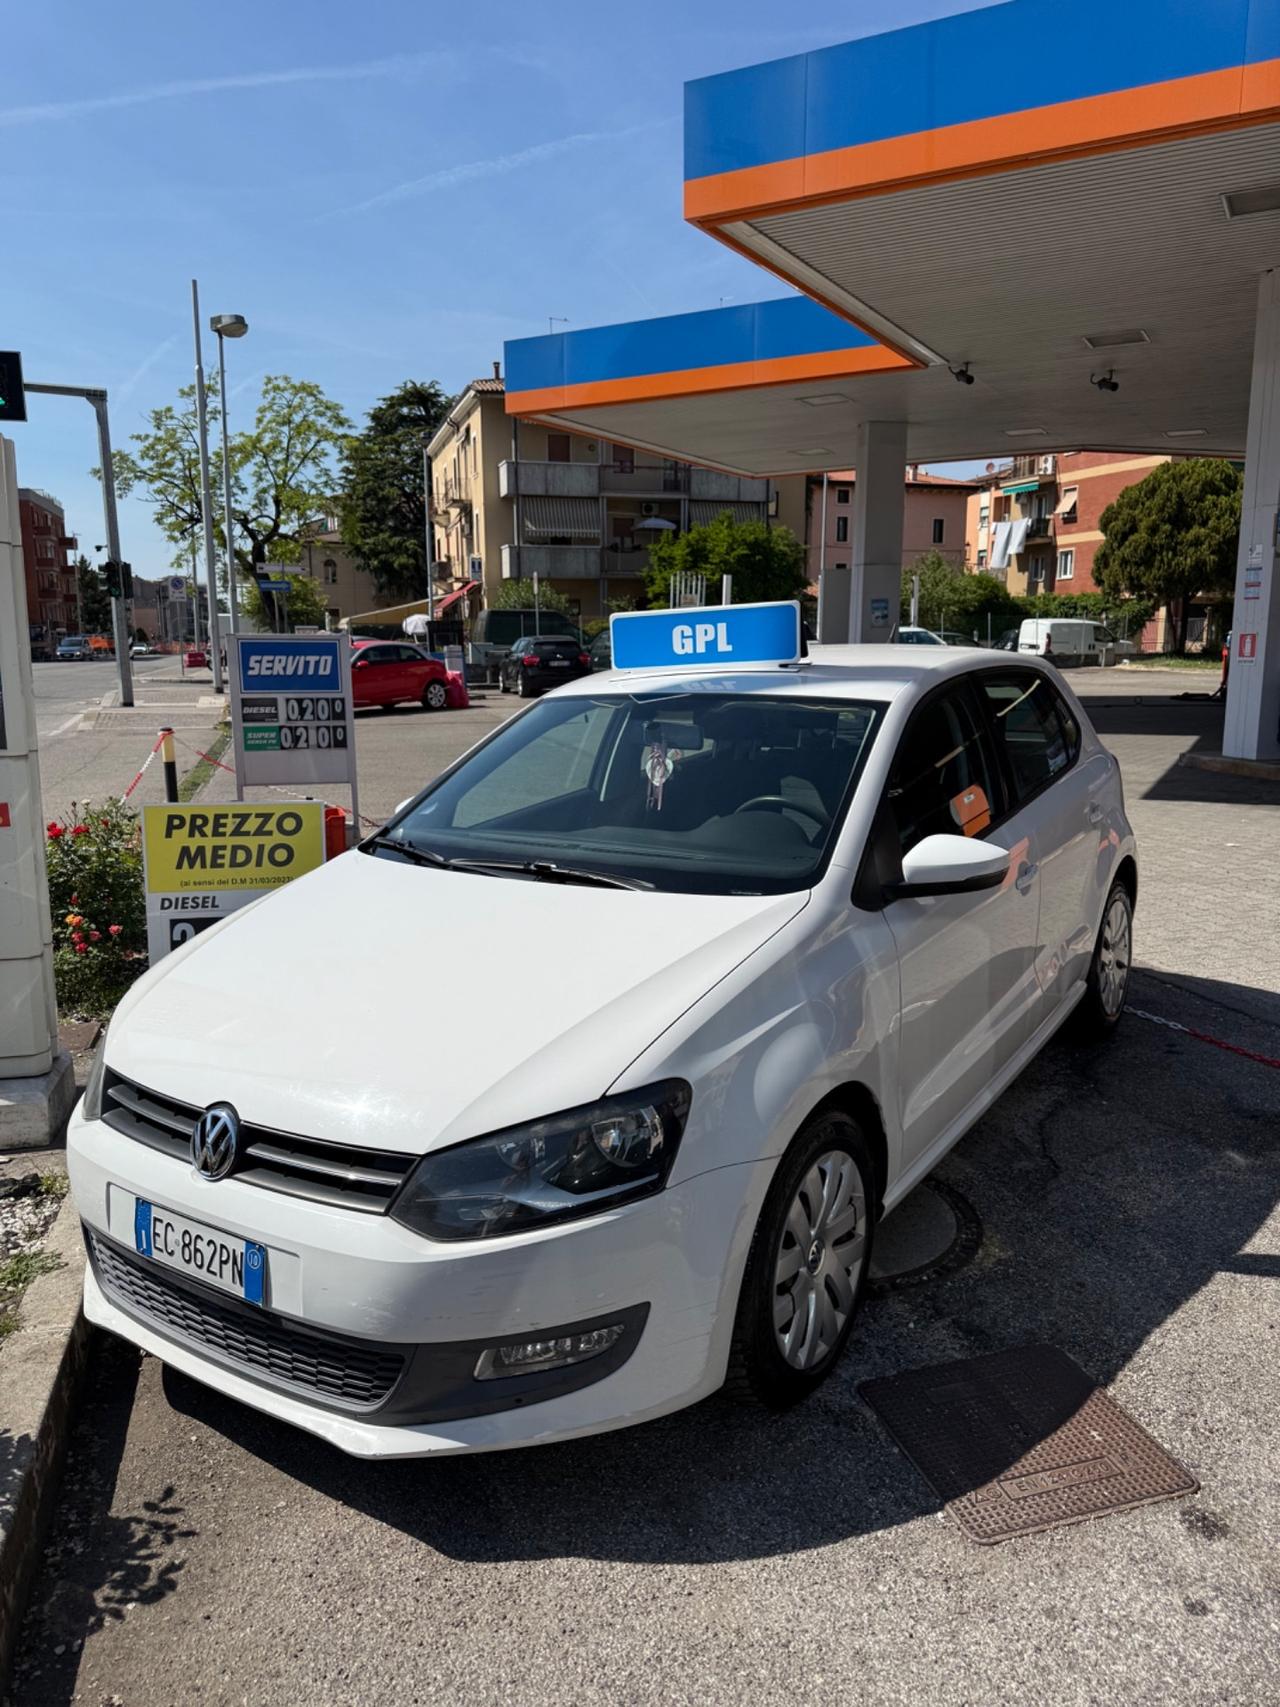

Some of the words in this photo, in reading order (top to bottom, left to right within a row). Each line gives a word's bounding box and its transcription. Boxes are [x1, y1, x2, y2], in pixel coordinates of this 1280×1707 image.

[672, 622, 733, 655] GPL
[247, 655, 333, 676] SERVITO
[243, 706, 277, 714] DIESEL
[164, 811, 304, 839] PREZZO
[175, 842, 296, 871] MEDIO
[193, 879, 215, 887] sensi
[160, 896, 220, 911] DIESEL
[153, 1216, 175, 1257] EC
[181, 1229, 244, 1288] 862PN
